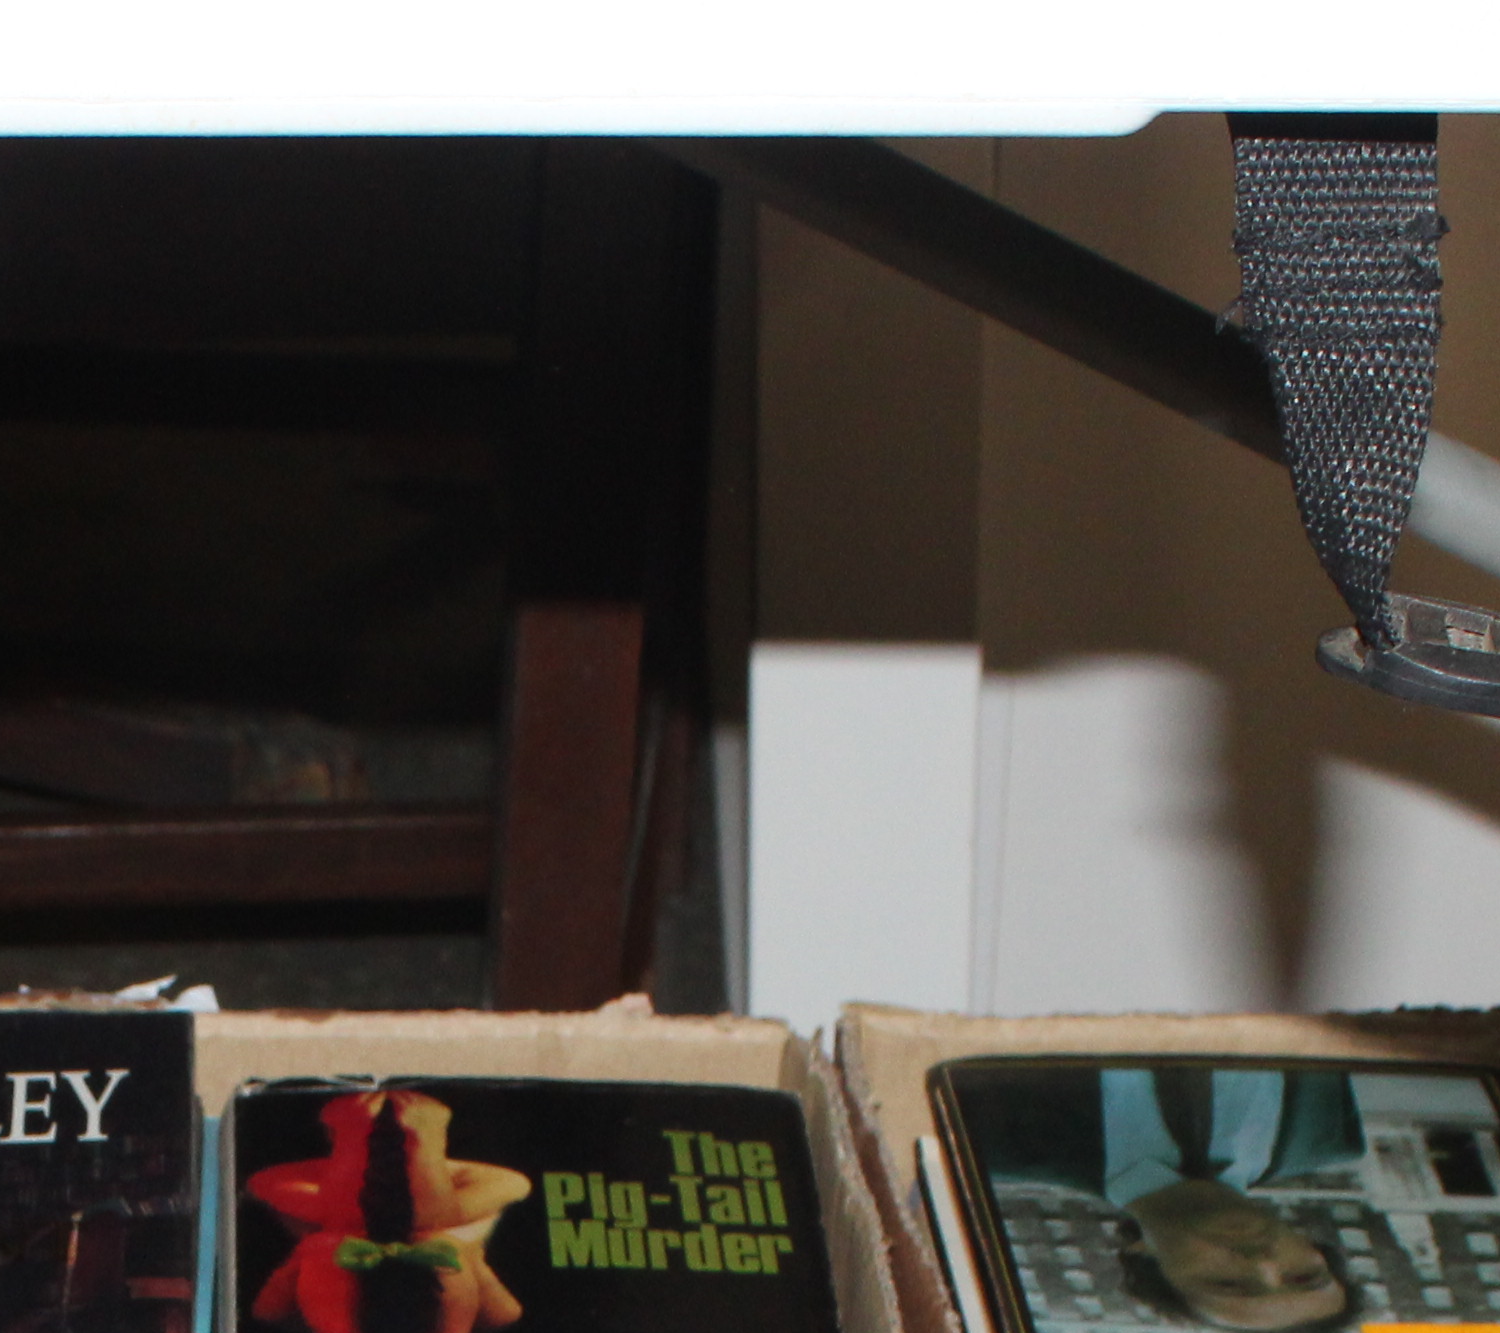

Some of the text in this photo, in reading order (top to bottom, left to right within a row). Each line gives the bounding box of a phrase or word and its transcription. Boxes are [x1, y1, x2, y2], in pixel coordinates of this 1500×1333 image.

[662, 1130, 777, 1179] The
[544, 1171, 788, 1229] Pig-Tail
[549, 1217, 793, 1274] Murder
